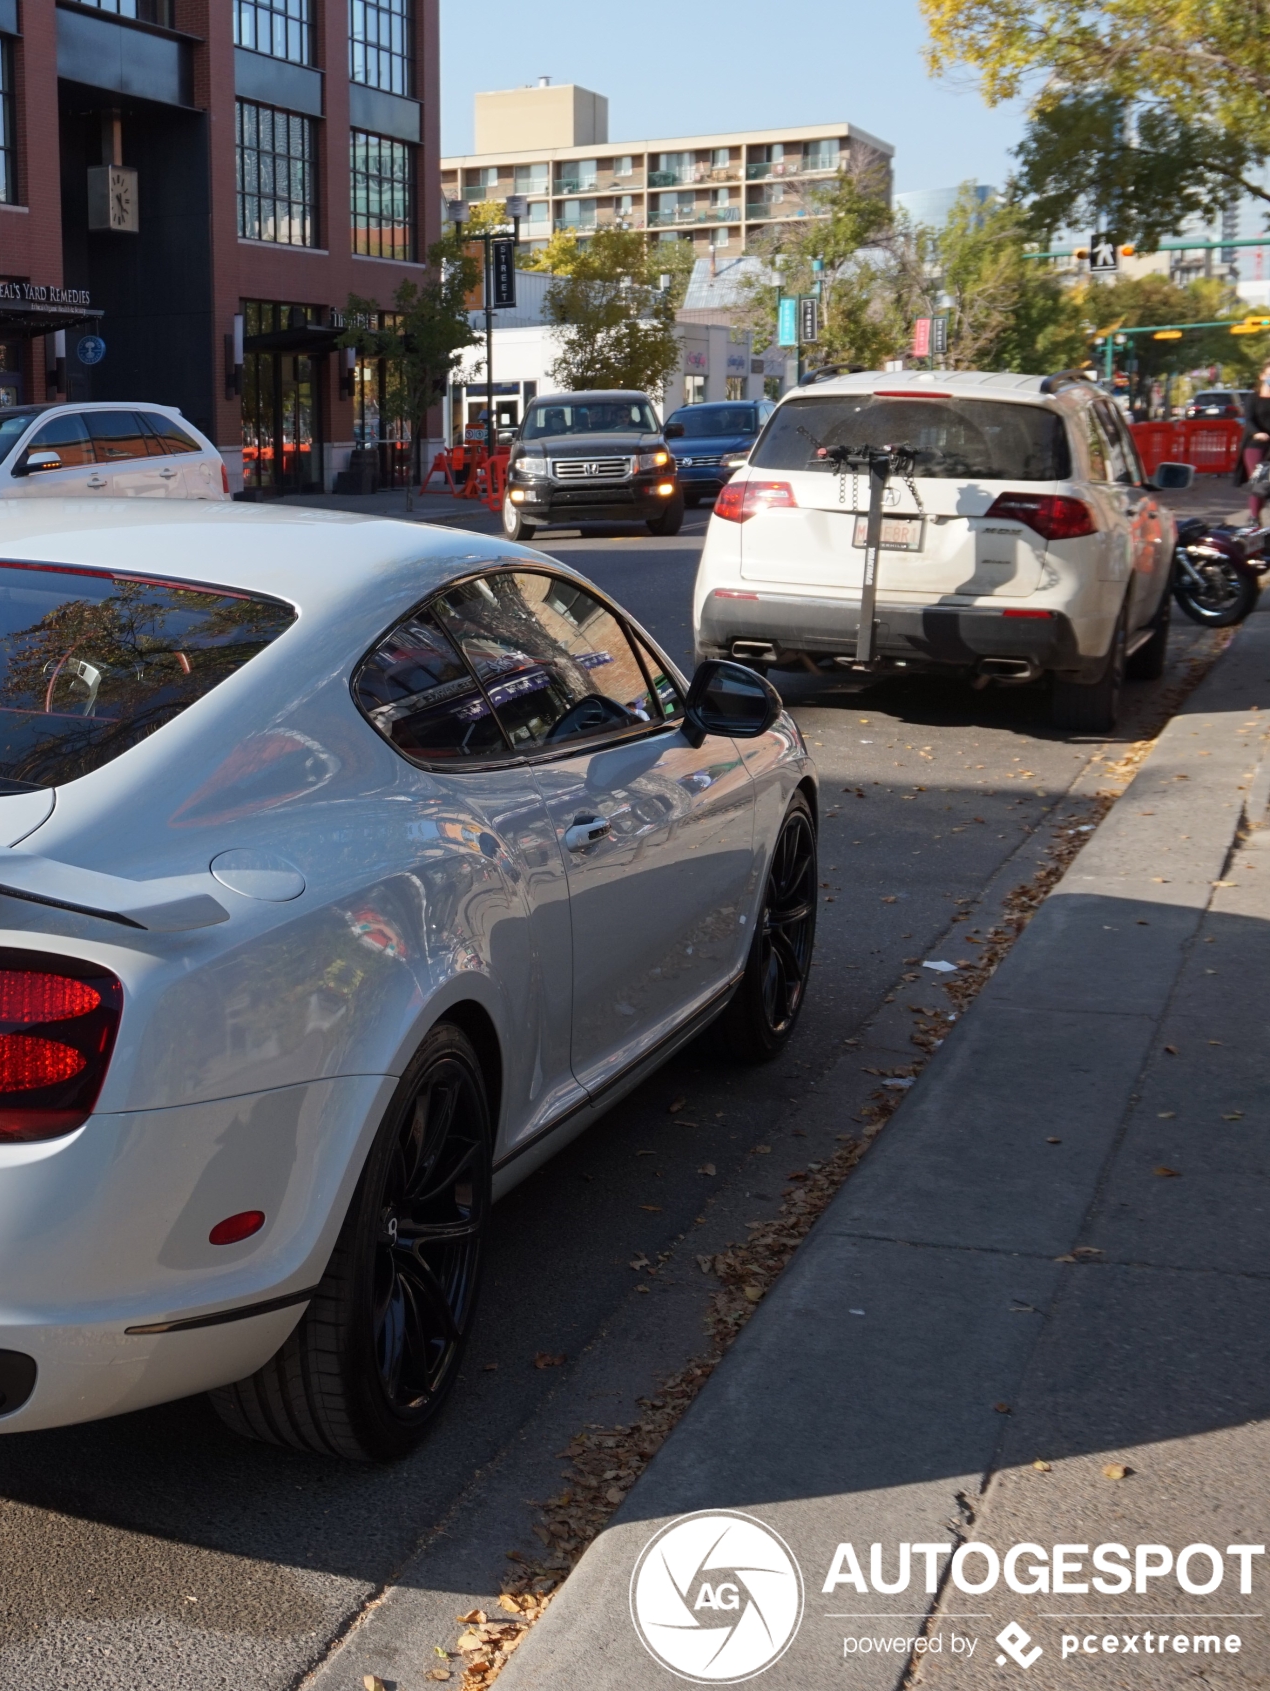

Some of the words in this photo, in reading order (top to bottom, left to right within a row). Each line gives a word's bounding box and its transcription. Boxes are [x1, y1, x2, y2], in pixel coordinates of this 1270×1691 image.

[22, 283, 47, 301] YARD
[50, 285, 90, 305] REMEDIES
[858, 524, 917, 542] ME8R1
